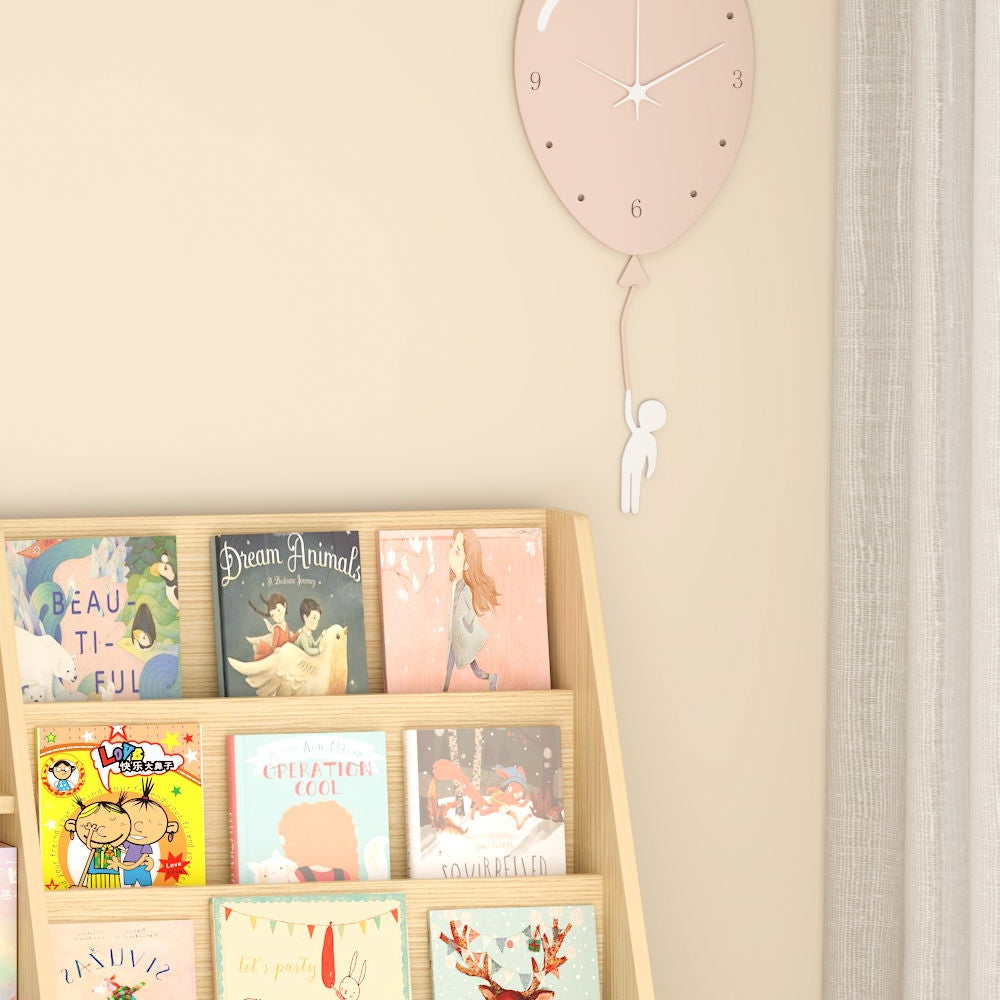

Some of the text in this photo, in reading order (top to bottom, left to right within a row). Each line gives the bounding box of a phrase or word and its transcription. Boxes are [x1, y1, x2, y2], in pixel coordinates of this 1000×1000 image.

[529, 71, 541, 91] 9
[732, 69, 743, 89] 3
[630, 198, 642, 218] 6
[220, 532, 360, 587] Dream Animals
[52, 589, 136, 615] BEAU-
[75, 631, 114, 655] TI-
[95, 669, 140, 694] FUL
[119, 760, 175, 773] 快乐大鼻子
[263, 761, 372, 779] OPERATION
[295, 779, 344, 796] COOL
[165, 860, 182, 869] Love
[239, 956, 319, 984] let's party
